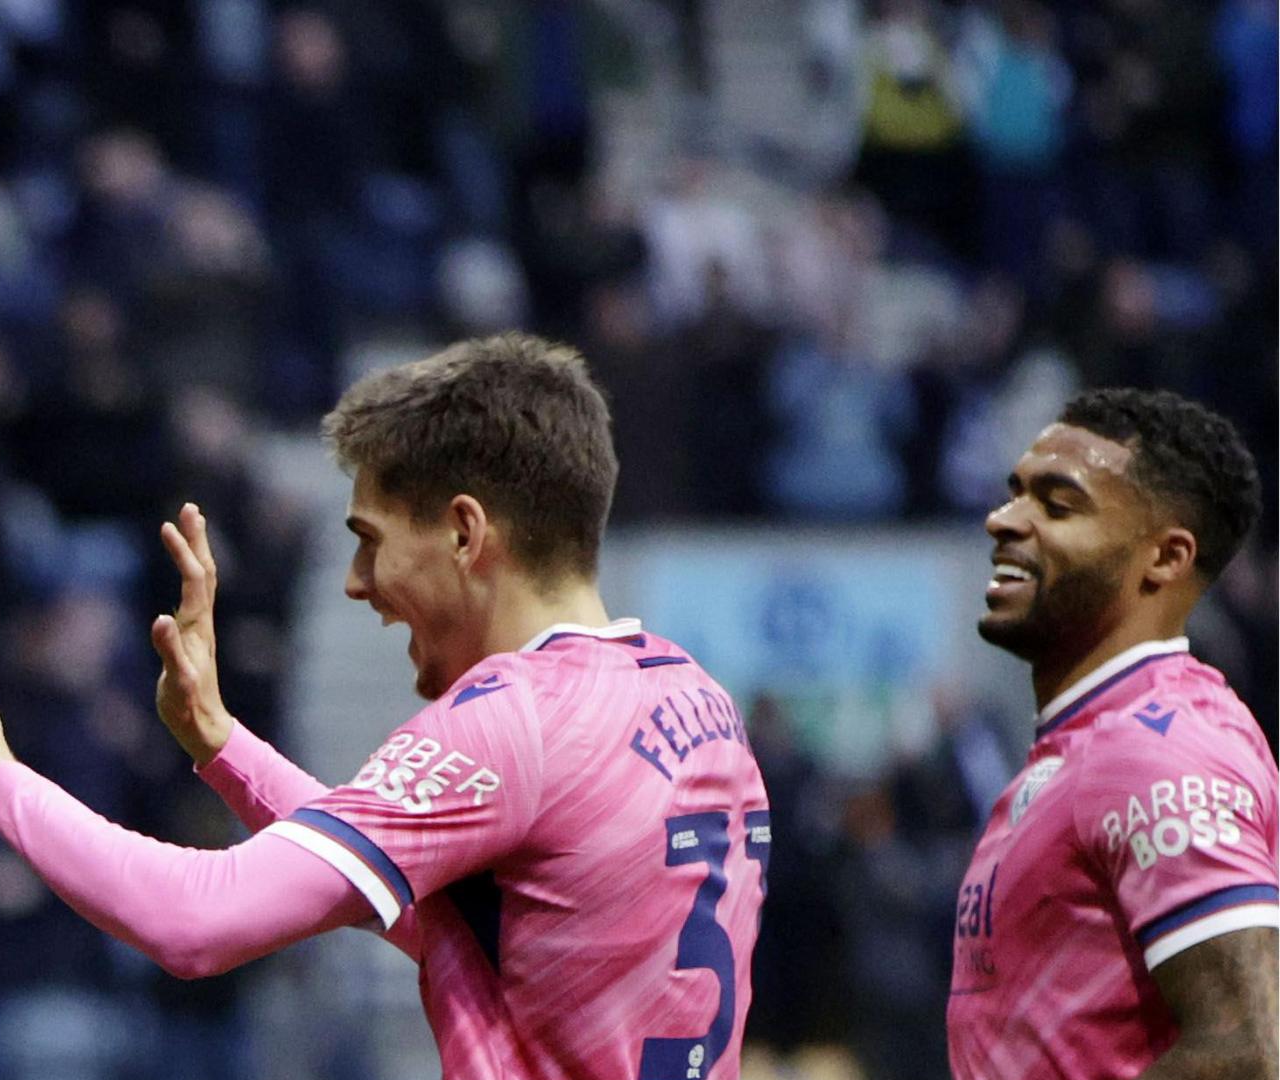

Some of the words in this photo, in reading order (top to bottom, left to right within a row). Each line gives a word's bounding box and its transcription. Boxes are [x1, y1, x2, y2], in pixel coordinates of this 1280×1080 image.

[352, 758, 444, 814] OSS
[377, 733, 501, 806] RBER
[1102, 775, 1255, 853] BARBER
[1130, 808, 1241, 870] BOSS
